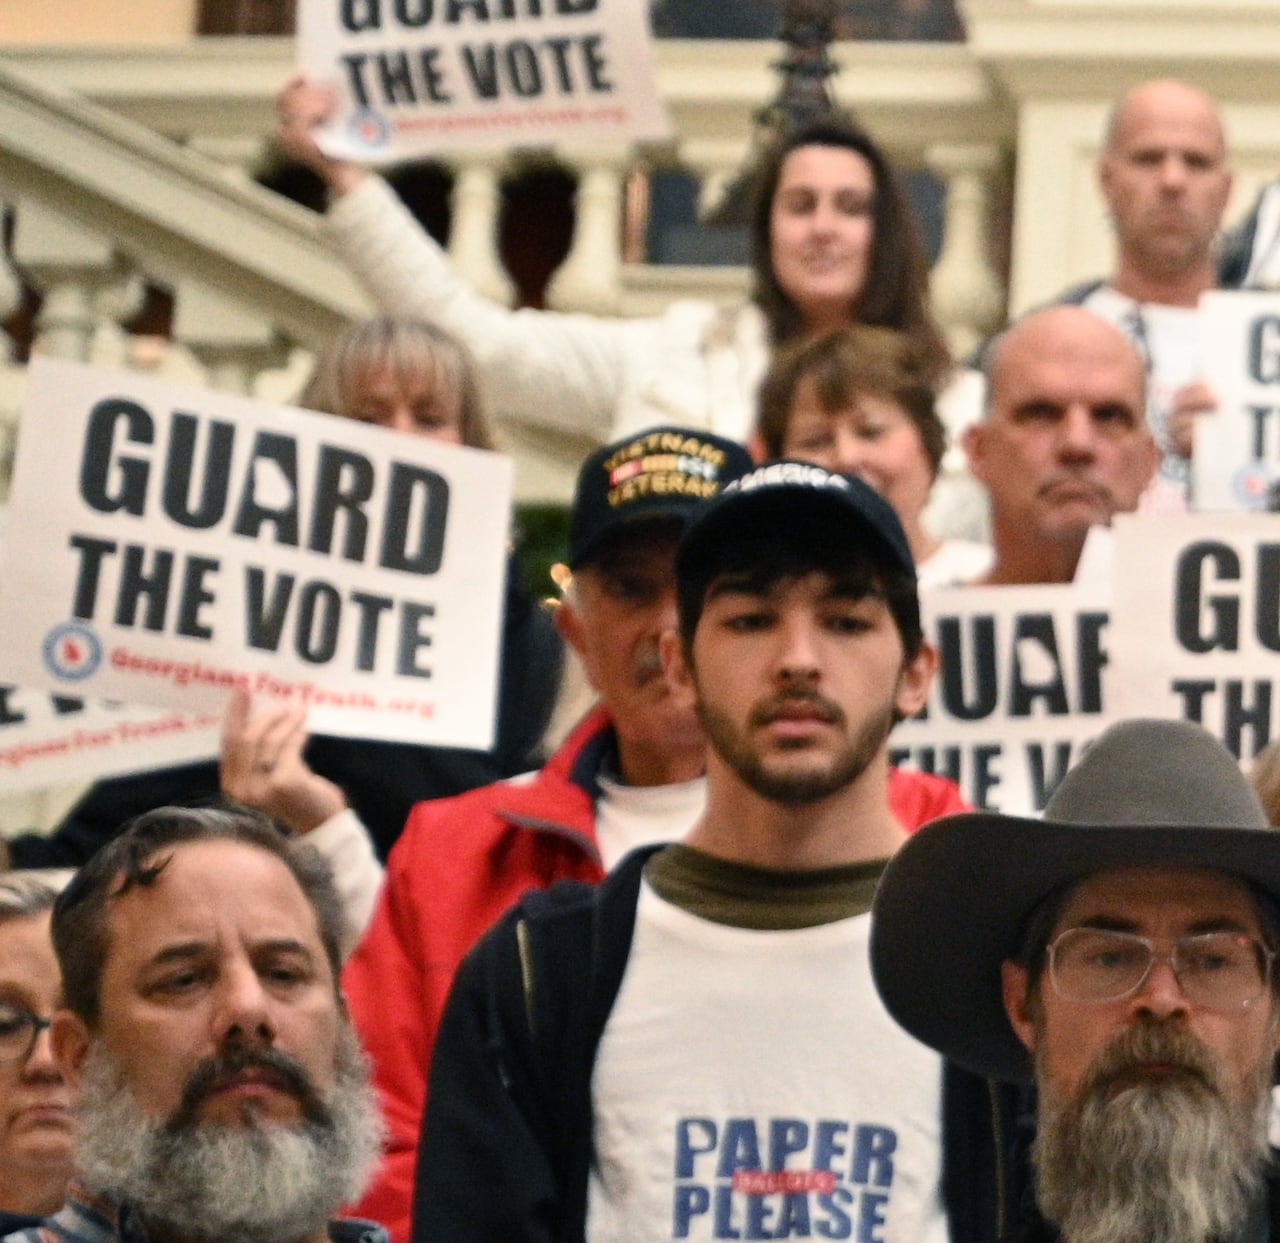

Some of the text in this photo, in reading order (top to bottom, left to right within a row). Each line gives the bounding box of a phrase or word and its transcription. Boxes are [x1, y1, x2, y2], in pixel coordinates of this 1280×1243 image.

[341, 36, 612, 105] THE VOTE
[78, 395, 450, 576] GUARD
[603, 433, 726, 471] VIETNAM
[70, 534, 436, 679] THE VOTE
[674, 1117, 898, 1187] PAPER
